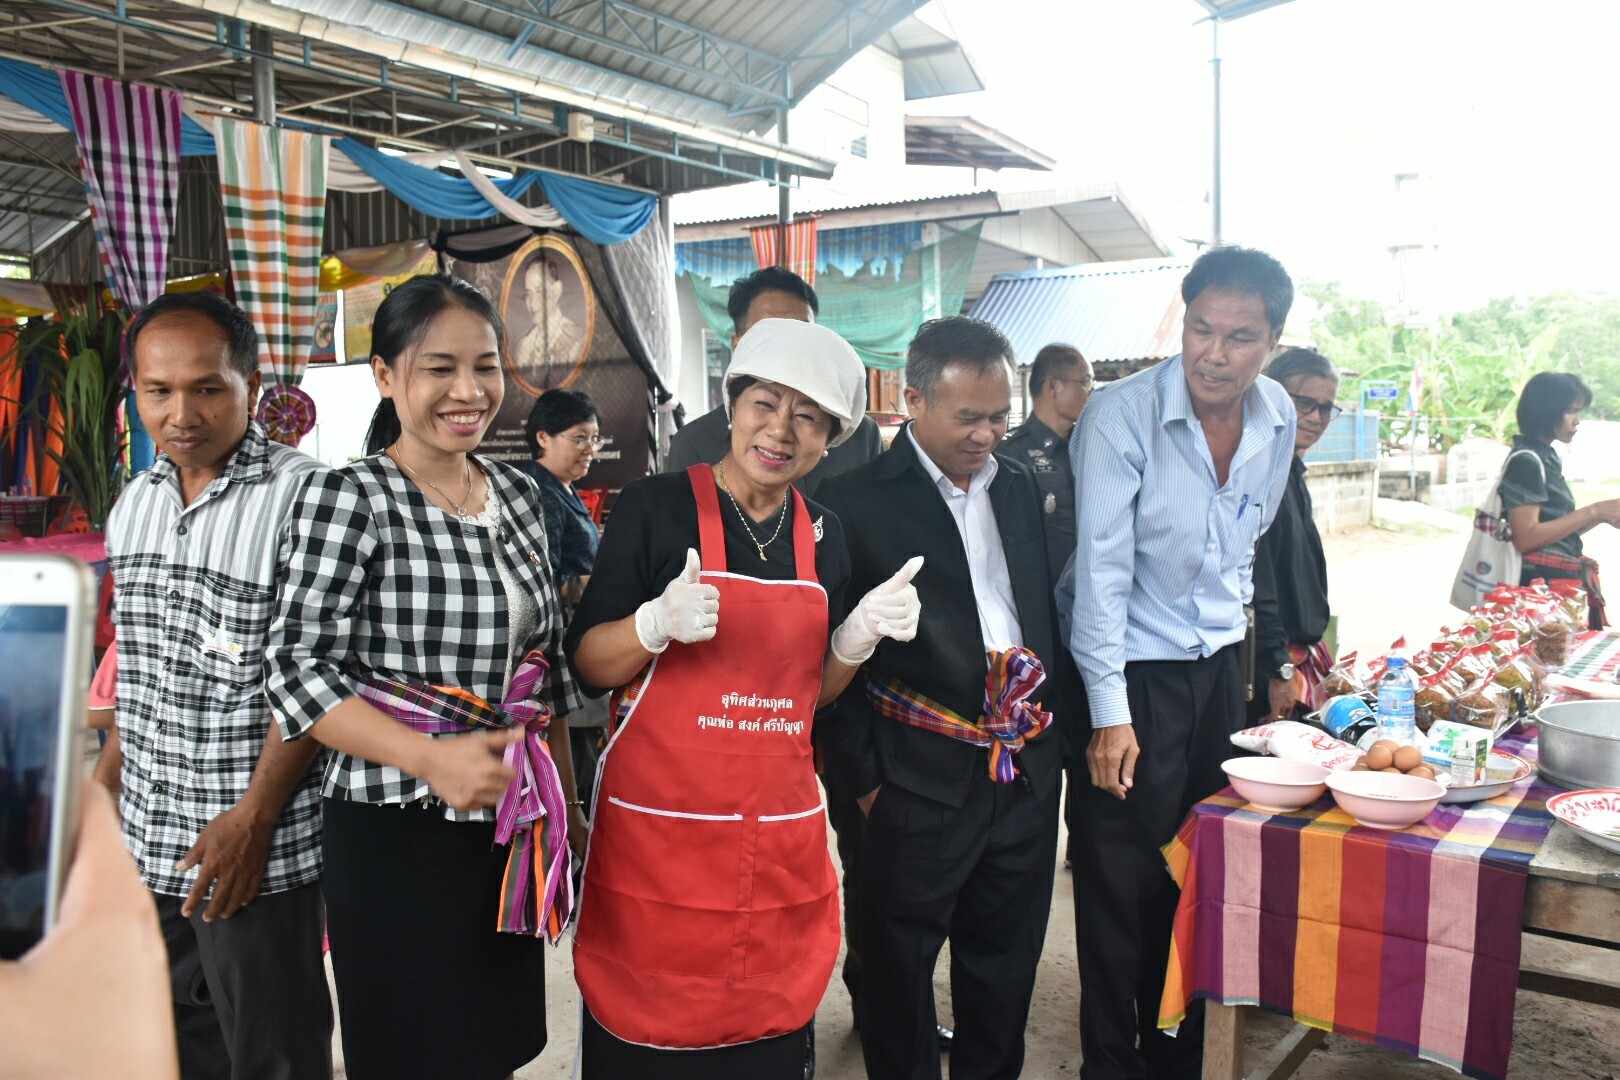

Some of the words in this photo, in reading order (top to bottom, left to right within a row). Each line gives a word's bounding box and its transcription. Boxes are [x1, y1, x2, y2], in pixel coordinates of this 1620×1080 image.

[721, 691, 793, 712] อุทิศส่วนกุศล
[697, 714, 734, 730] คุณพ่อ
[763, 717, 804, 735] ศรีปัญญา
